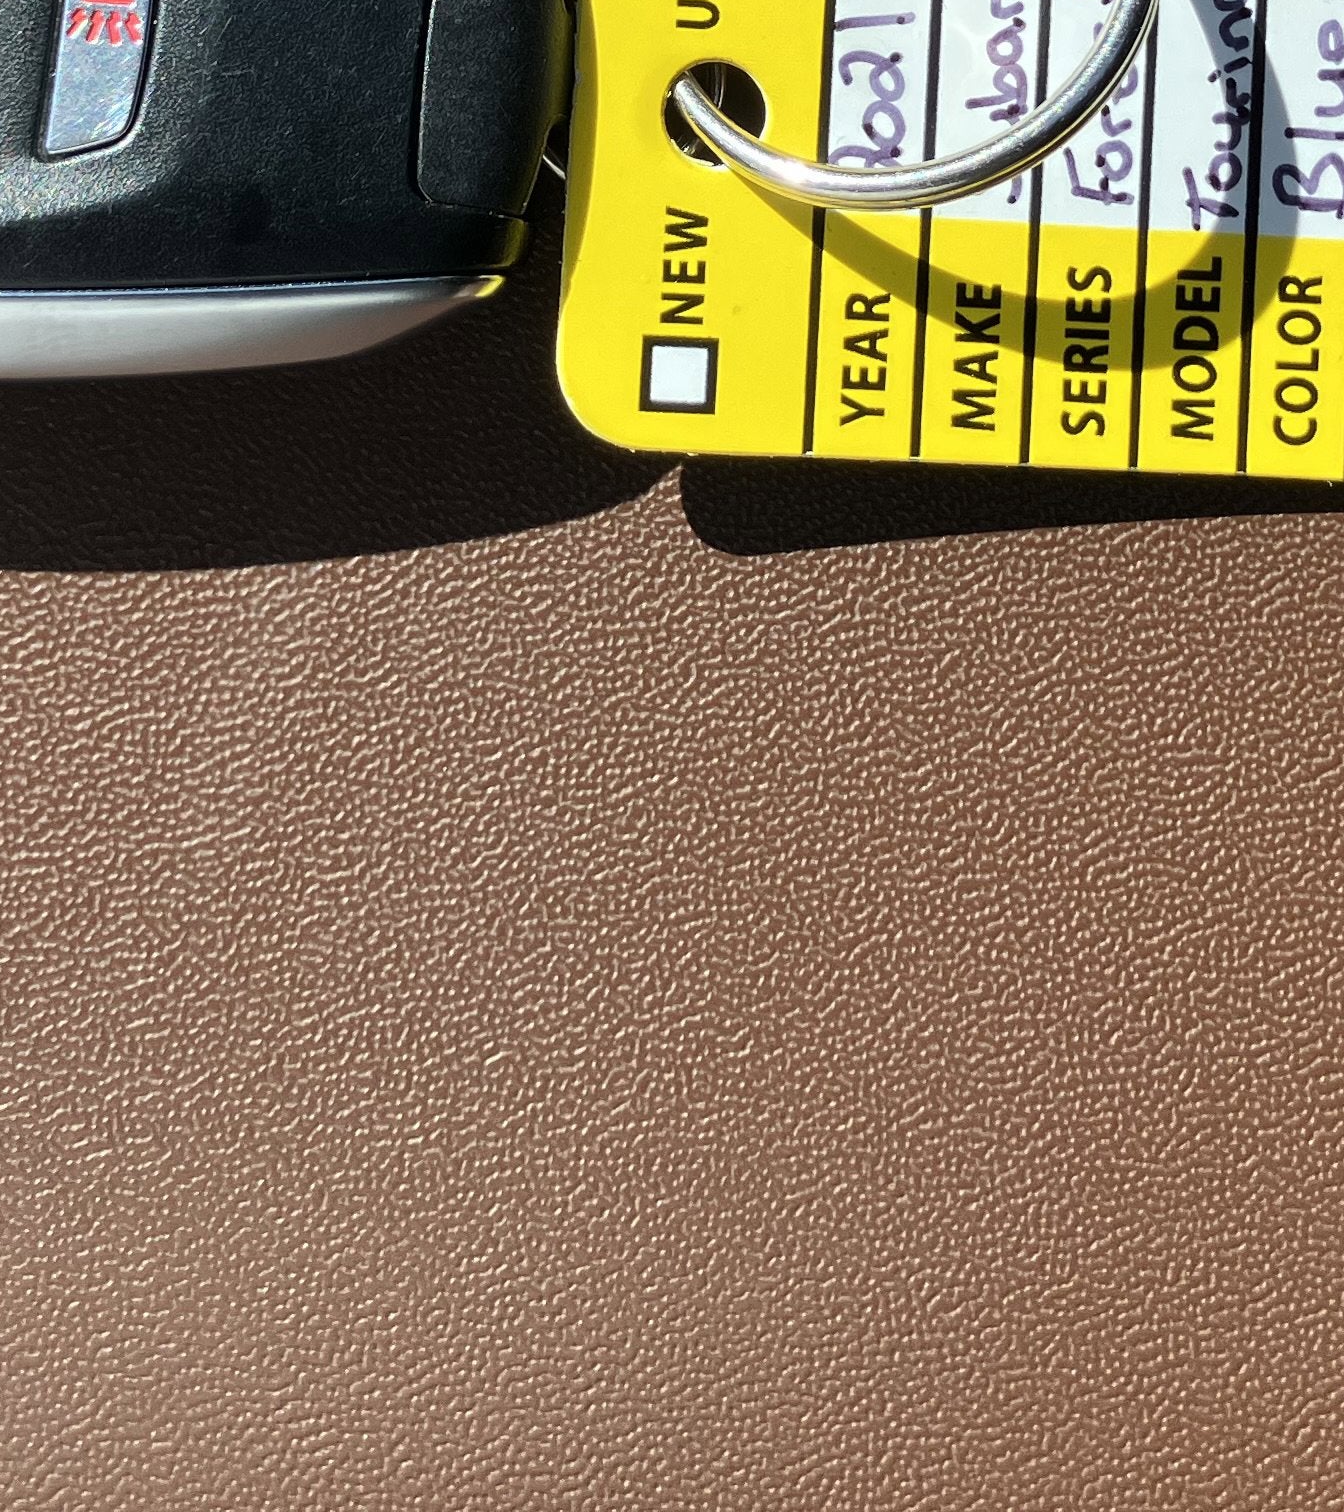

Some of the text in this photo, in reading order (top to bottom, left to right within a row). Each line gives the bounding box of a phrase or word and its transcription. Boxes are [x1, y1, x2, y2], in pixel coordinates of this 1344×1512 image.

[829, 12, 915, 169] 2021
[661, 205, 710, 326] NEW
[840, 292, 890, 425] YEAR
[951, 283, 1002, 432] MAKE
[1061, 266, 1112, 436] SERIES
[1172, 256, 1222, 441] MODEL
[1273, 274, 1323, 446] COLOR
